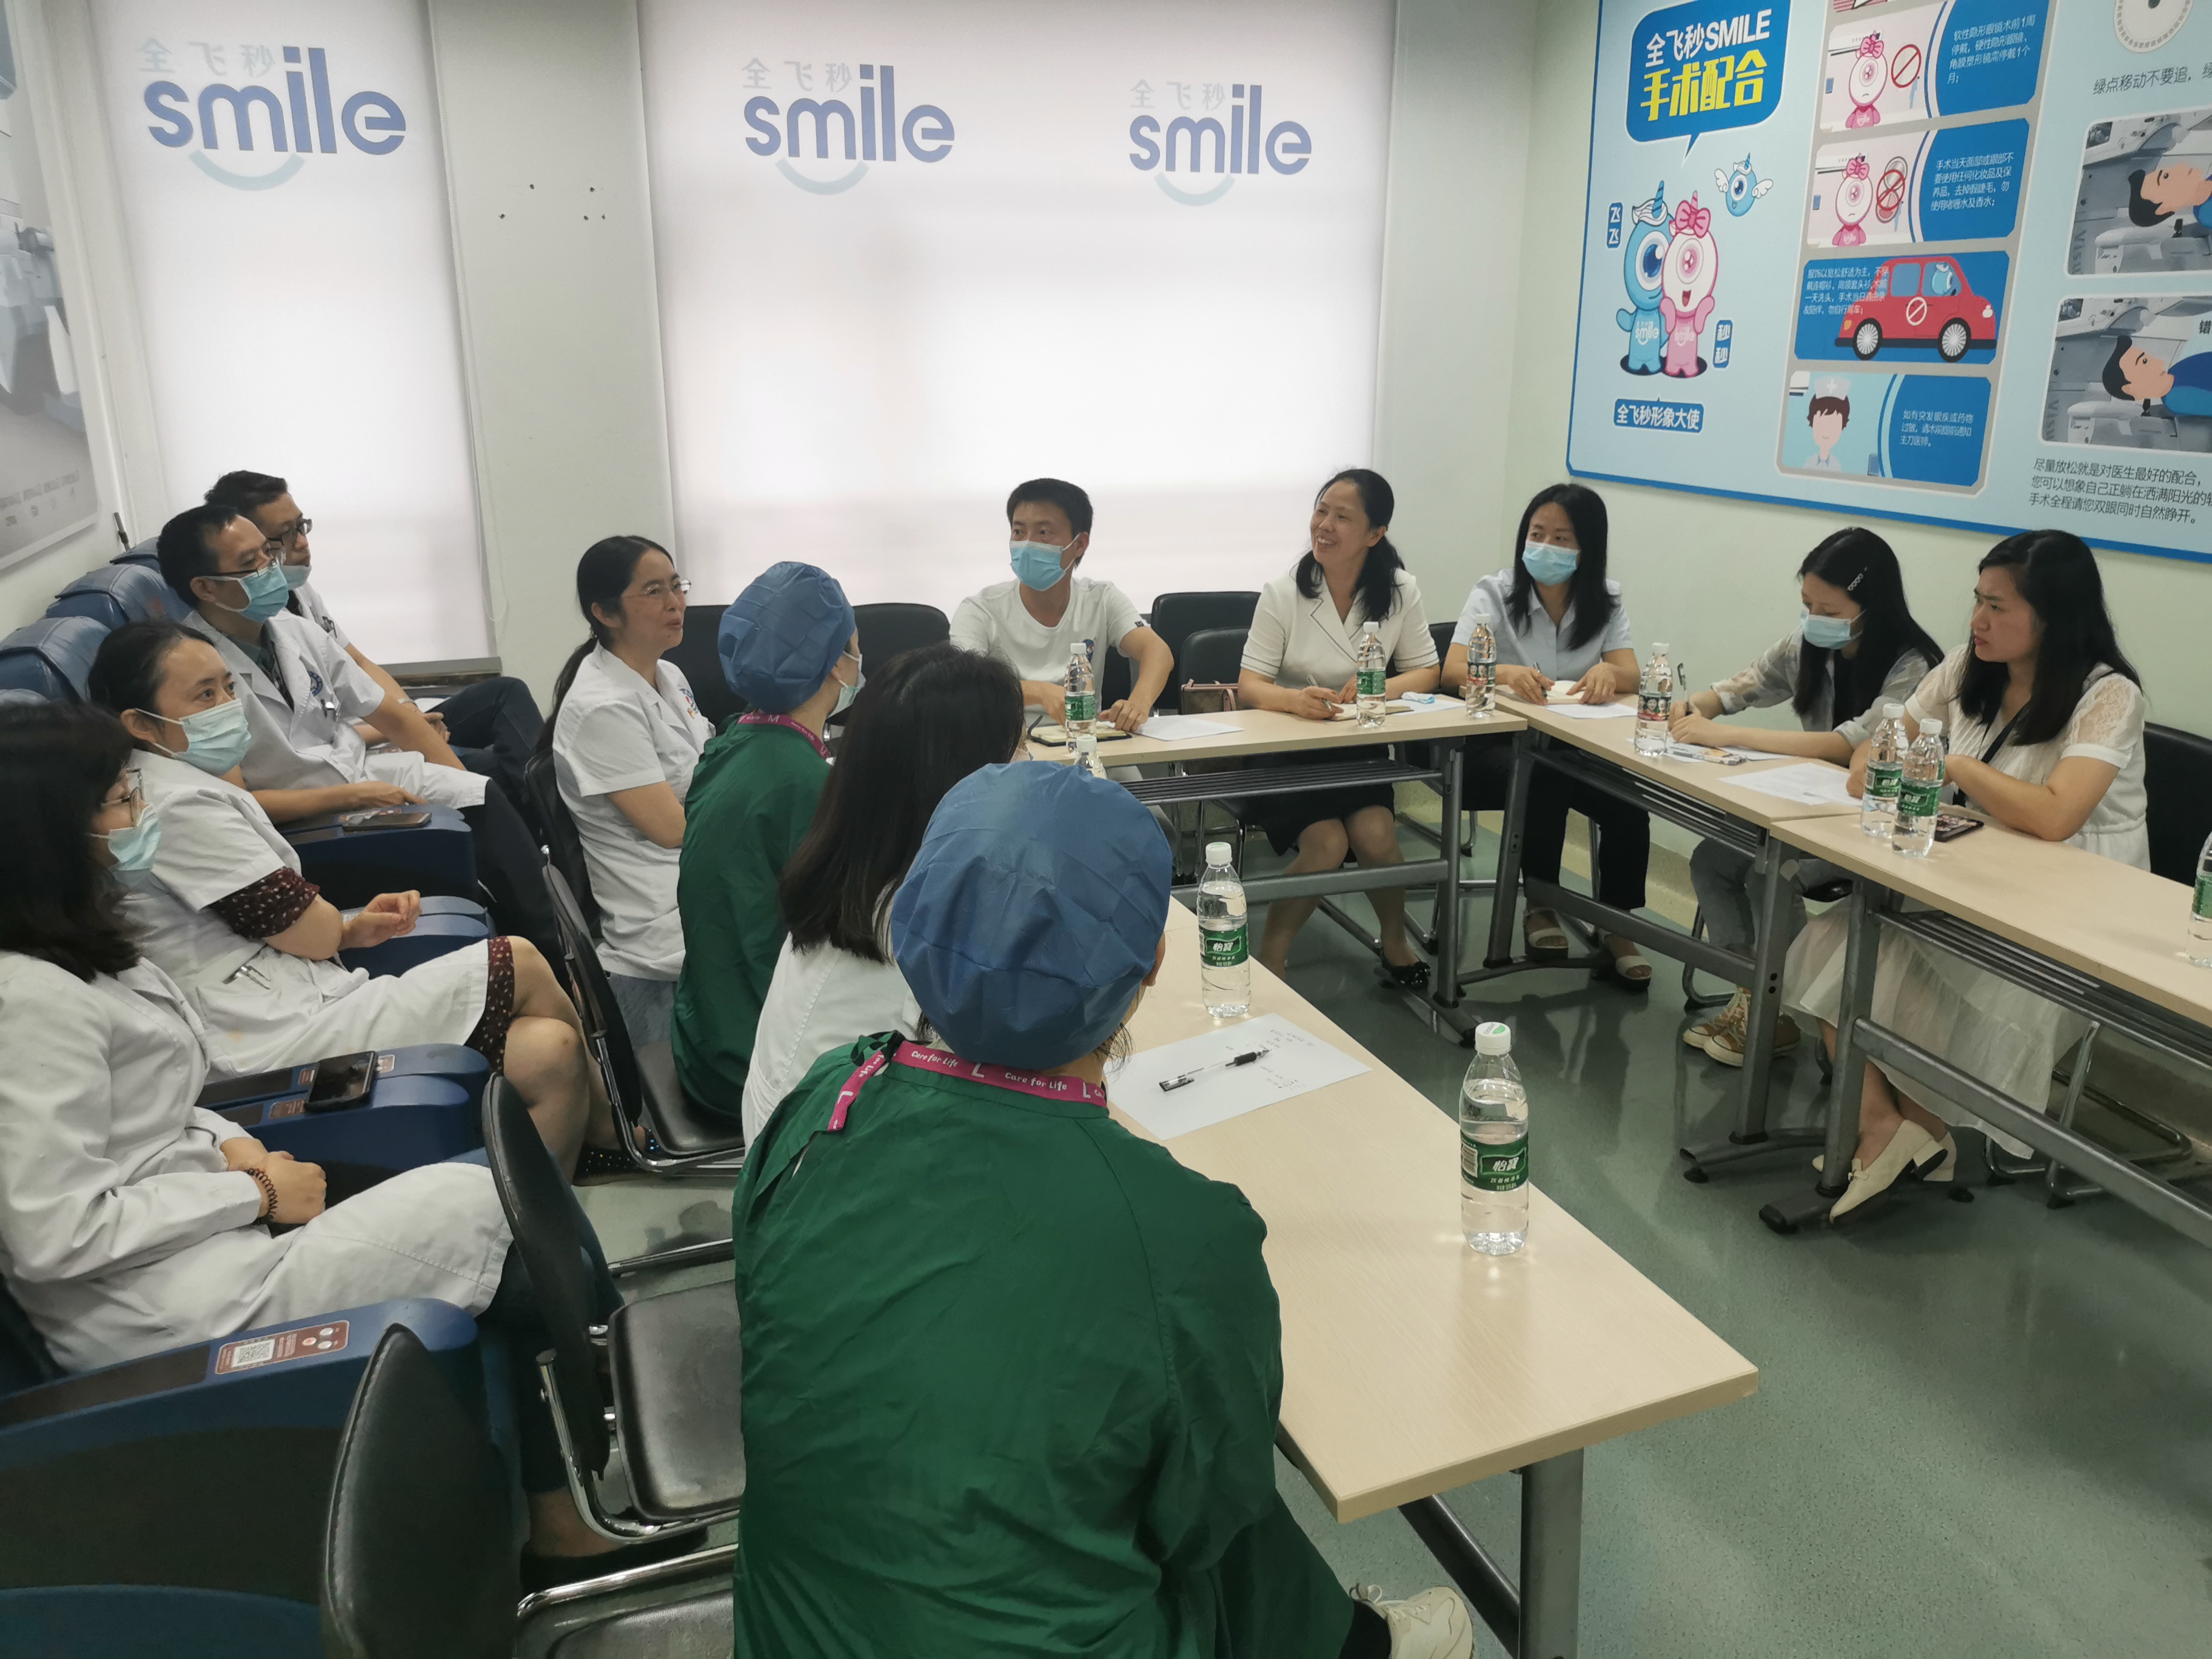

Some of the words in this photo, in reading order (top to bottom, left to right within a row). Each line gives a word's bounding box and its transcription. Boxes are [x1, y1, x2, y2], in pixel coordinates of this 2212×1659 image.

[139, 36, 275, 77] 全飞秒
[1646, 10, 1771, 68] 全飞秒SMILE
[742, 57, 853, 92] 全飞秒
[1130, 79, 1225, 111] 全飞秒
[1640, 49, 1768, 121] 手术配合
[144, 45, 406, 155] smile
[743, 64, 954, 163] smile
[1130, 84, 1312, 175] smile
[1609, 206, 1620, 244] 飞飞
[1715, 324, 1731, 364] 秒秒
[1617, 403, 1700, 430] 全飞秒形象大使
[911, 1051, 928, 1060] Care
[927, 1054, 942, 1062] for
[943, 1057, 958, 1068] Life
[1005, 1072, 1028, 1083] Care
[1030, 1078, 1046, 1087] for
[1049, 1081, 1067, 1091] Life
[1082, 1082, 1091, 1098] L
